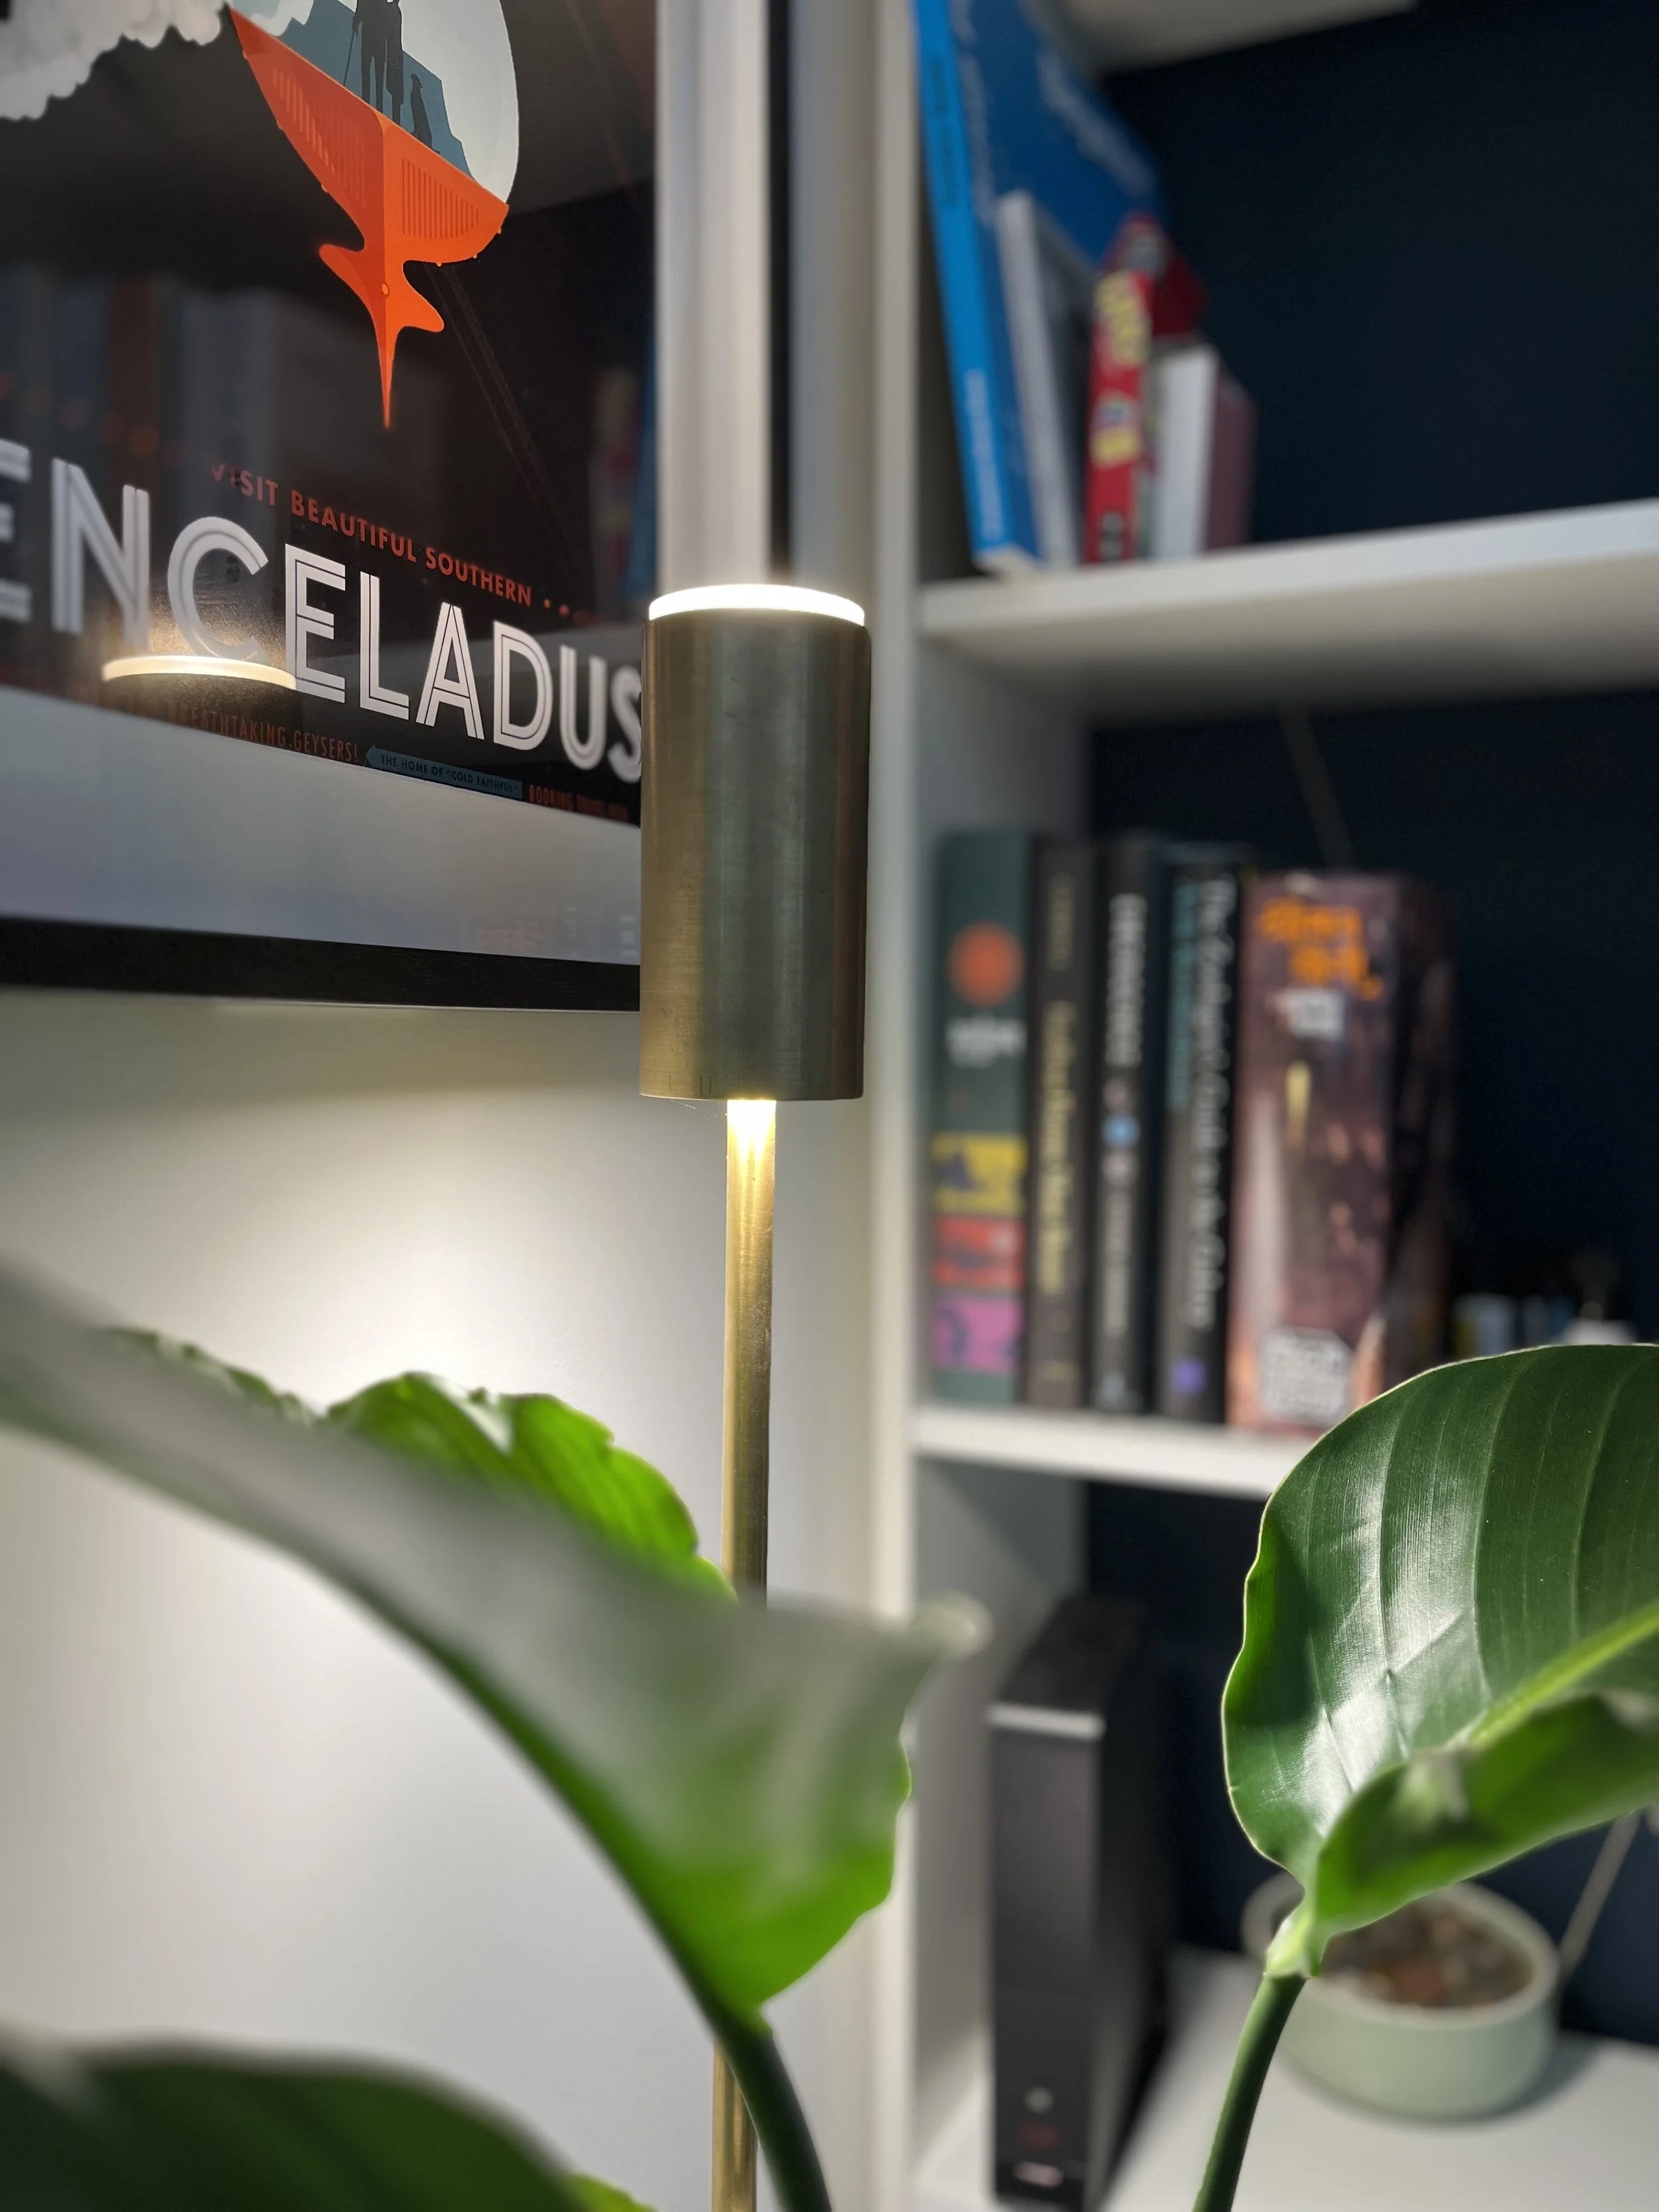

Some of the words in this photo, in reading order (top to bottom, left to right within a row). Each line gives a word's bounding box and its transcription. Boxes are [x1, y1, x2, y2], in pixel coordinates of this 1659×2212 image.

[212, 461, 279, 507] VISIT
[291, 489, 417, 563] BEAUTIFUL
[425, 546, 532, 607] SOUTHERN
[293, 730, 359, 763] GEYSERS!
[380, 753, 398, 767] THE
[400, 759, 429, 774] HOME
[431, 765, 444, 777] OF
